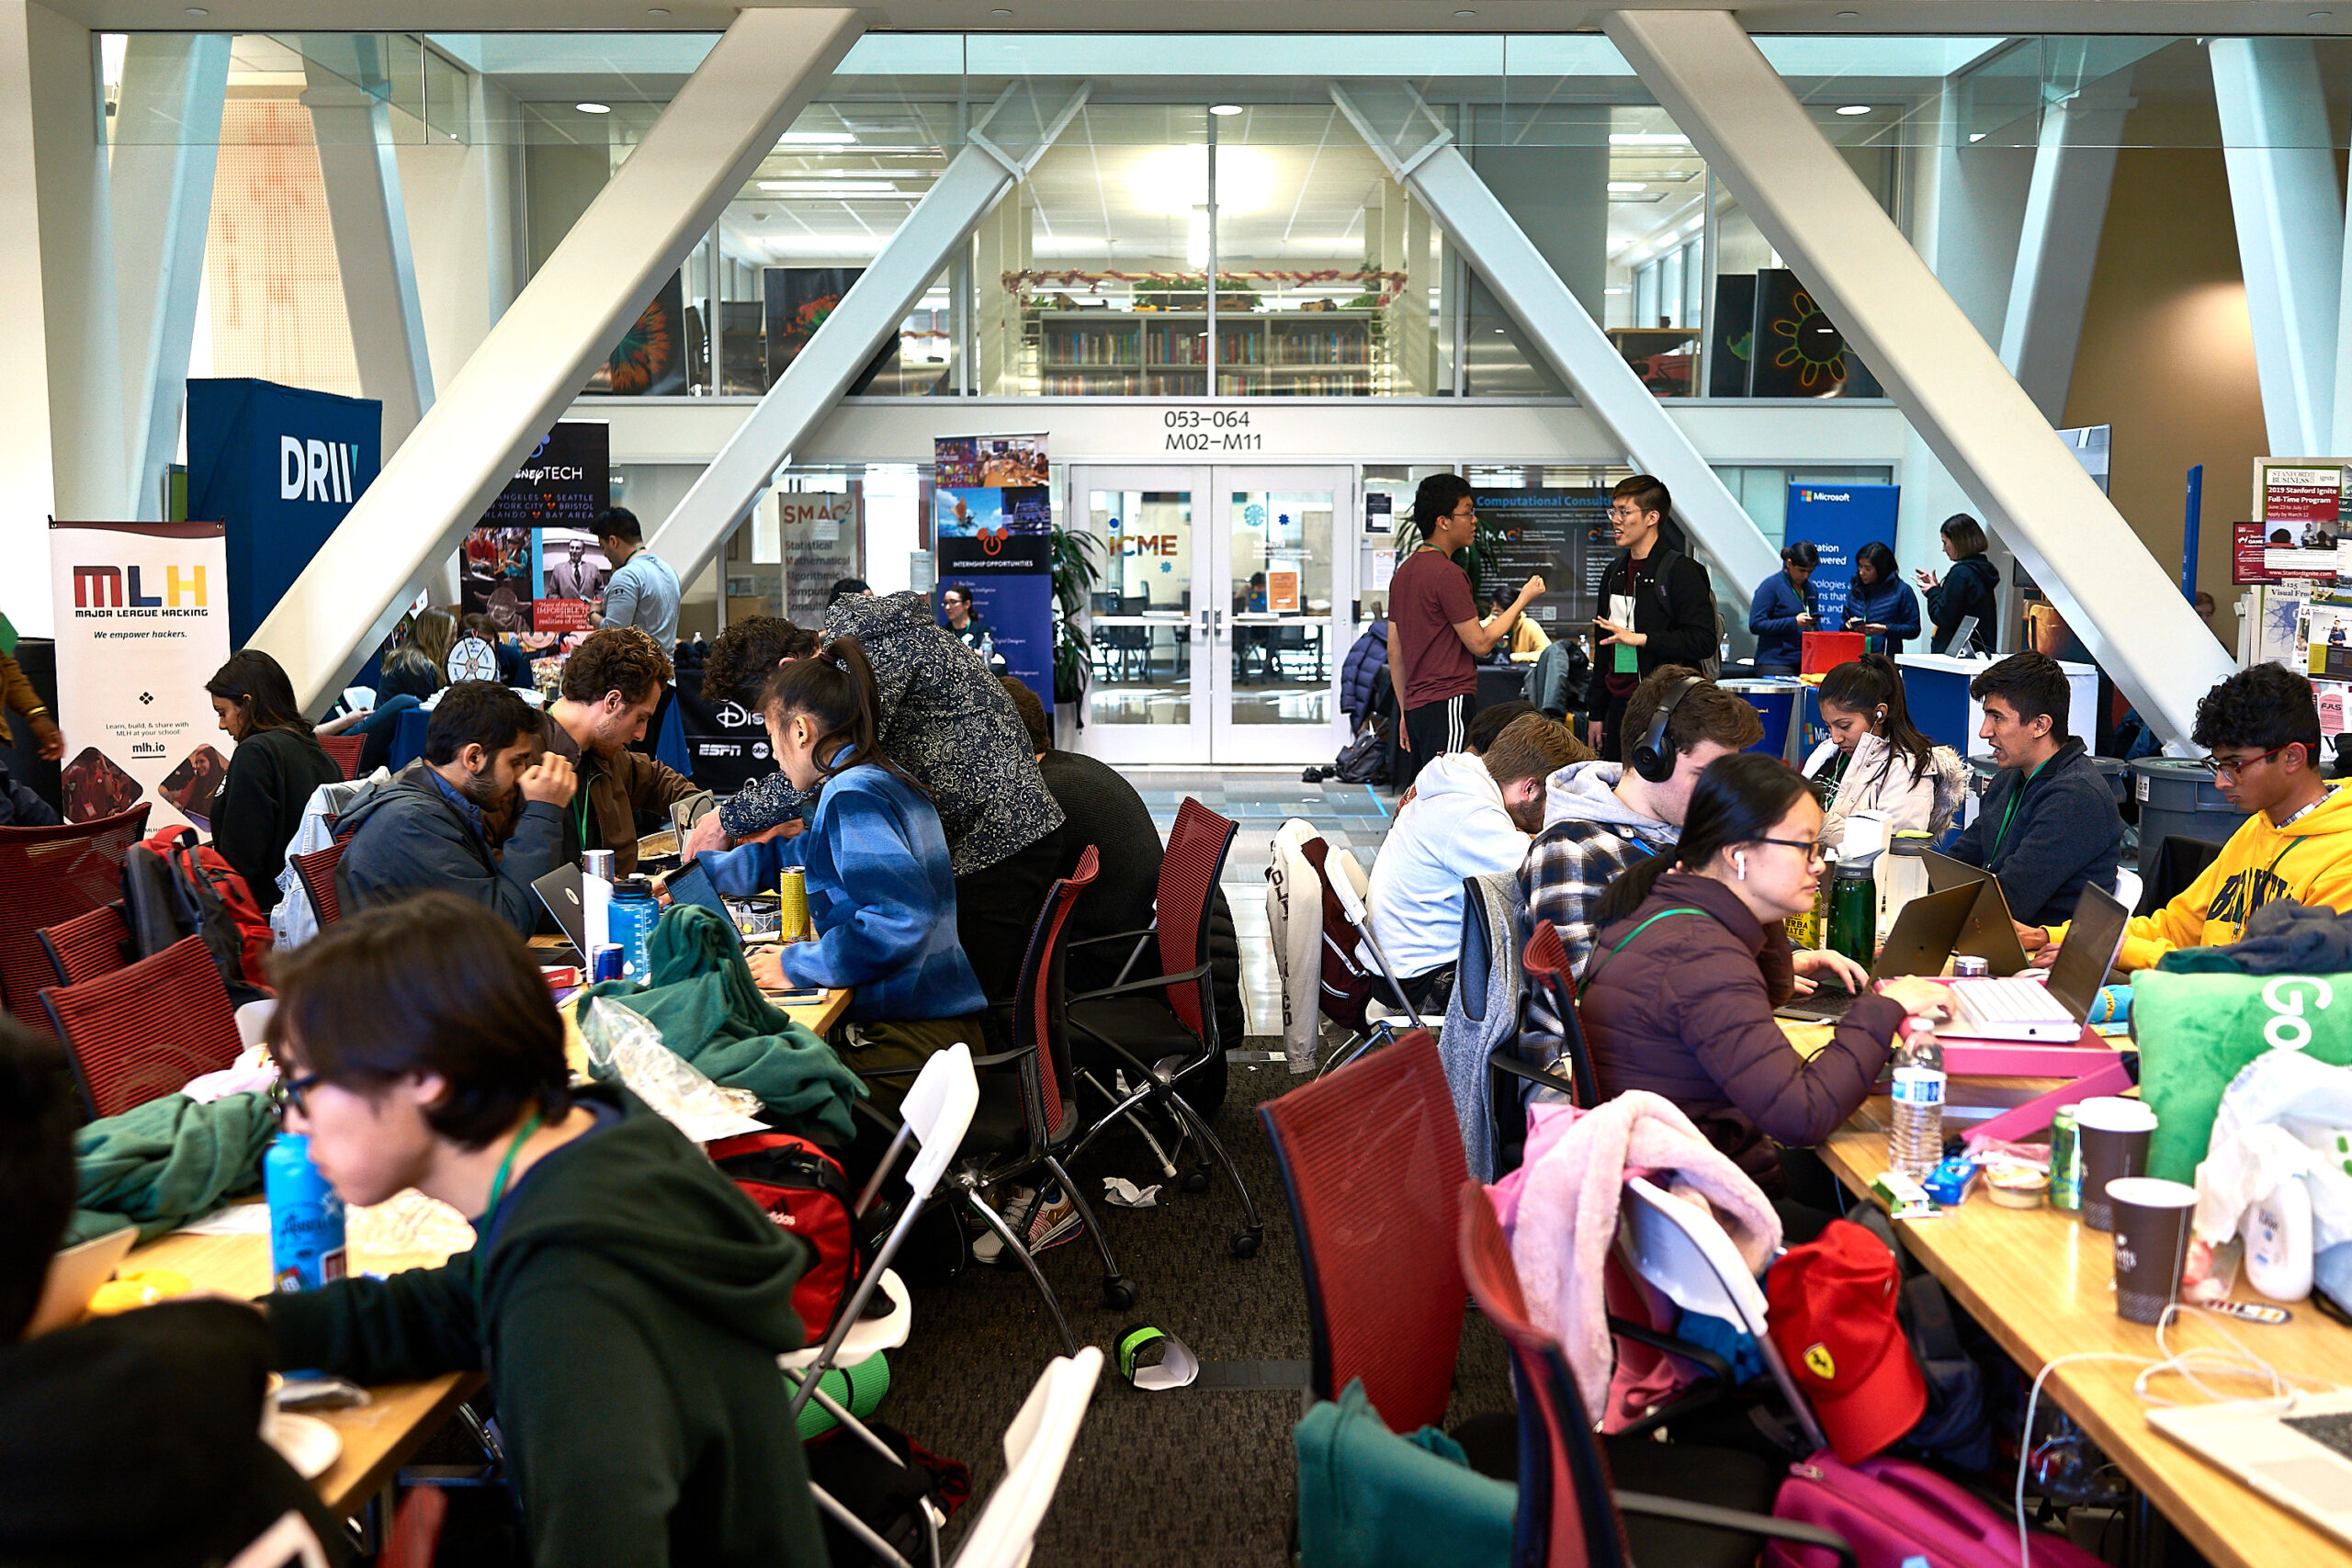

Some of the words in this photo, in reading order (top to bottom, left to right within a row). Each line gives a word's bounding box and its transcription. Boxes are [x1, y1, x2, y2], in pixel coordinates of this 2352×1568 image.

[1164, 411, 1250, 428] 053-064
[1165, 434, 1261, 450] M02-M11
[1814, 491, 1850, 502] Microsoft
[2267, 486, 2285, 494] 2019
[2285, 486, 2316, 495] Stanford
[2316, 488, 2337, 496] Ignite
[556, 493, 594, 502] SEATTLE
[1476, 495, 1562, 508] Computational
[1564, 495, 1613, 506] Consulti
[2267, 495, 2301, 503] Full-Time
[2301, 497, 2332, 505] Program
[559, 502, 594, 511] BRISTOL
[786, 540, 832, 551] Statistical
[1109, 535, 1178, 557] ICME
[786, 555, 851, 566] Mathematical
[73, 565, 209, 608] MLH
[1830, 591, 1847, 602] that
[2271, 588, 2293, 597] Visual
[75, 609, 113, 618] MAJOR
[117, 609, 158, 618] LEAGUE
[162, 609, 209, 617] HACKING
[1826, 604, 1844, 613] and
[94, 630, 107, 639] We
[109, 630, 150, 641] empower
[152, 629, 187, 639] hackers.
[128, 722, 147, 730] build,
[132, 742, 165, 753] mlh.io
[699, 743, 742, 757] ESPN
[752, 745, 769, 754] abc
